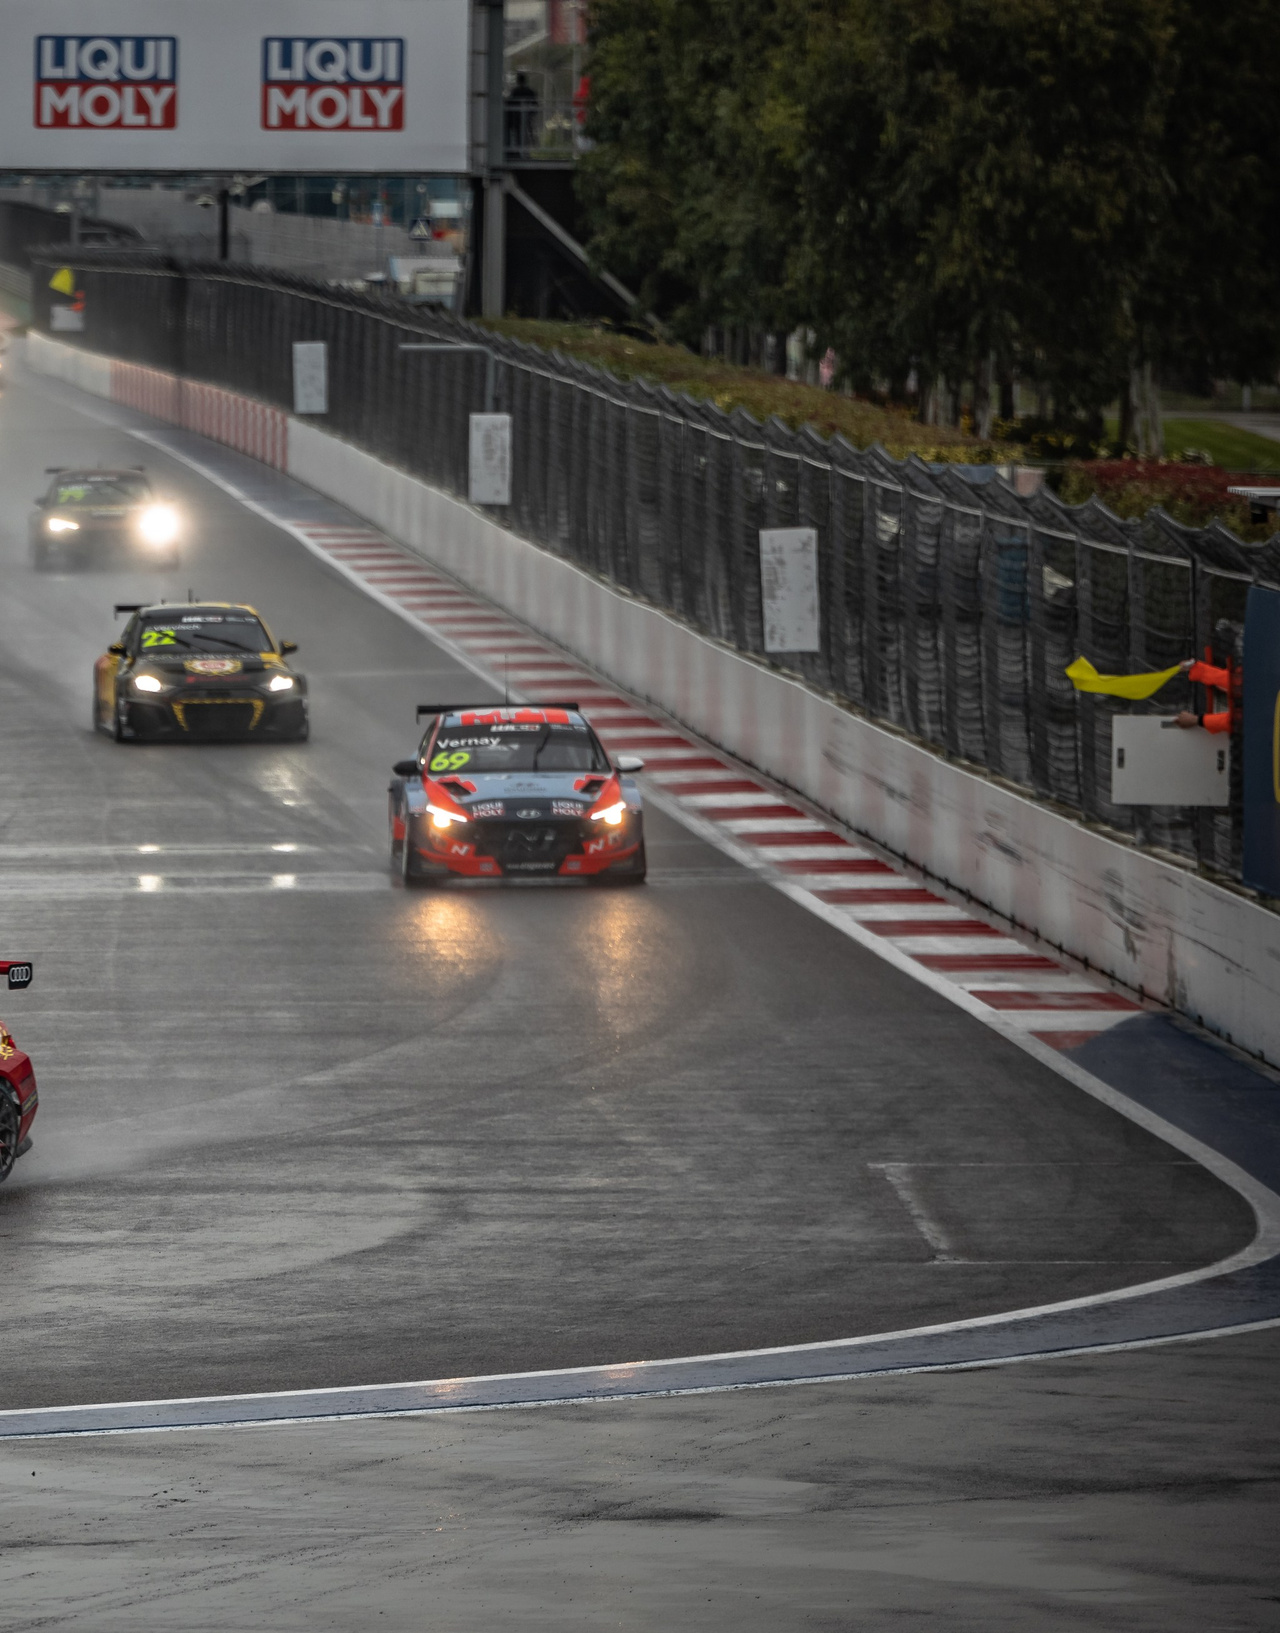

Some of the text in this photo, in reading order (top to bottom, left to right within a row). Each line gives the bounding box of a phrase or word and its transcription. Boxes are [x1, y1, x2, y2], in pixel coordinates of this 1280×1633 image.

[40, 38, 170, 82] LIQUI
[267, 39, 398, 83] LIQUI
[40, 84, 173, 127] MOLY
[267, 85, 401, 128] MOLY
[141, 630, 176, 648] 22
[429, 752, 470, 772] 69
[436, 736, 501, 749] Vernay
